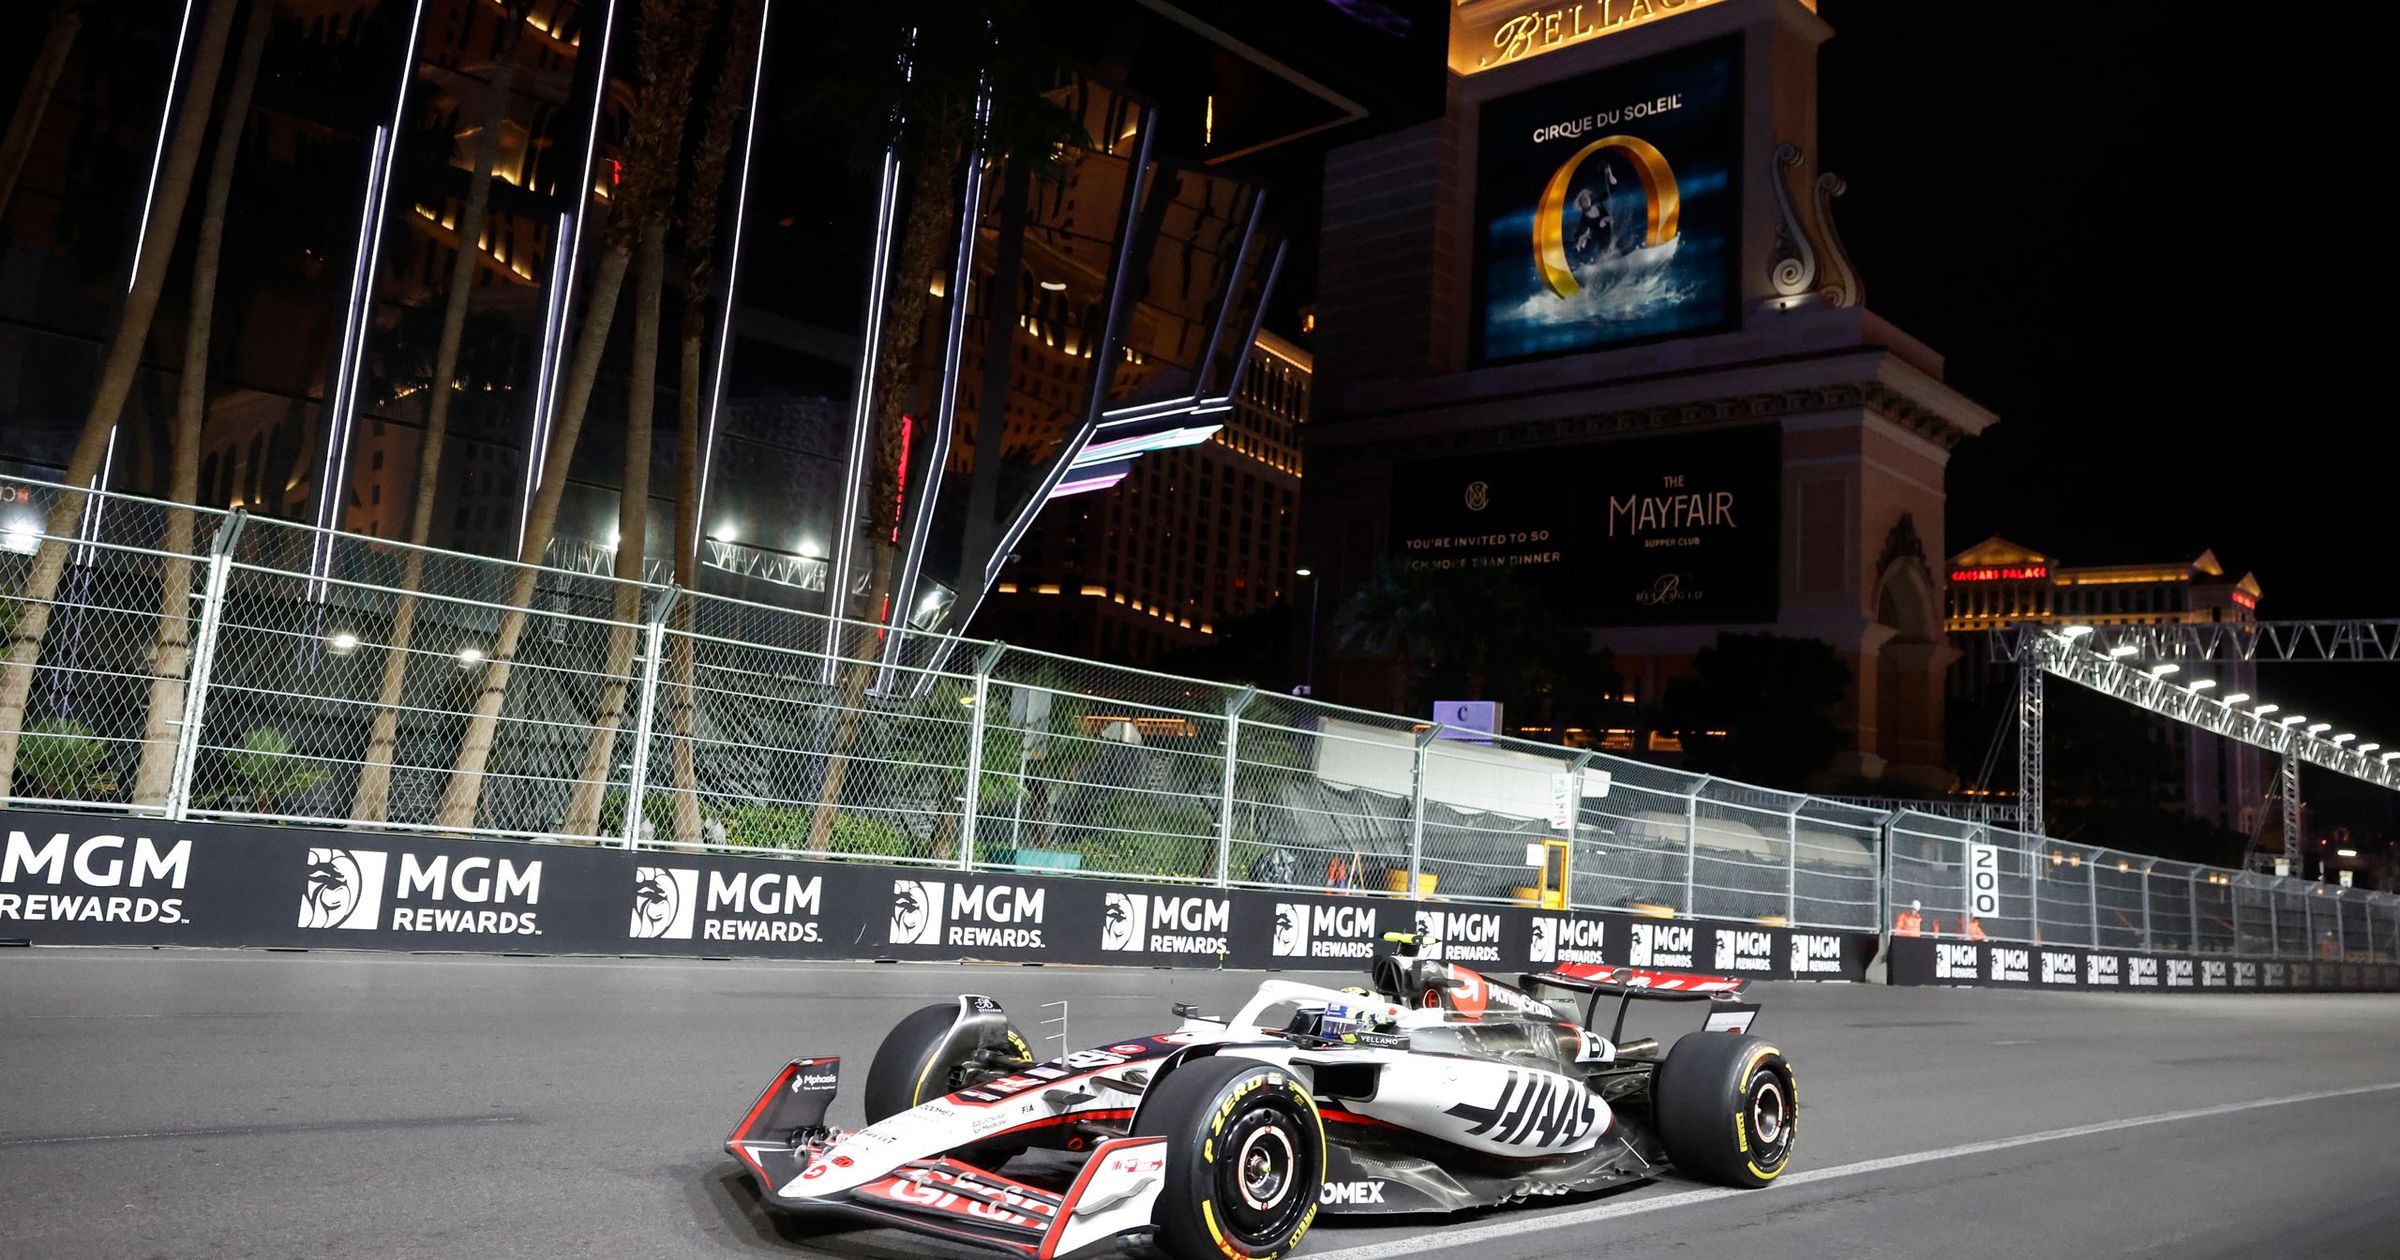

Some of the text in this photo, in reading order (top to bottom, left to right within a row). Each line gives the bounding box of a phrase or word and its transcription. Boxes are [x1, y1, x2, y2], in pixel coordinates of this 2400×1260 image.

[1480, 0, 1704, 66] BELLA
[1533, 117, 1593, 143] CIRQUE
[1597, 110, 1620, 128] DU
[1662, 474, 1685, 489] THE
[1608, 491, 1738, 538] MAYFAIR
[1406, 529, 1550, 551] YOU'RE INVITED TO SO
[1644, 535, 1701, 549] SUPPER CLUB
[1509, 551, 1561, 566] DINNER
[2002, 567, 2047, 579] PALACE
[1, 831, 192, 888] MGM
[397, 853, 542, 904] MGM
[707, 871, 822, 915] MGM
[1976, 849, 1995, 913] 200
[951, 884, 1045, 923] MGM
[1152, 897, 1229, 932] MGM
[1313, 906, 1375, 938] MGM
[1446, 912, 1499, 942] MGM
[1559, 918, 1604, 947] MGM
[1654, 926, 1693, 951] MGM
[1736, 932, 1771, 956] MGM
[1808, 936, 1840, 958] MGM
[1951, 945, 1978, 966] MGM
[1360, 1034, 1398, 1046] VELLAMO
[803, 1073, 837, 1086] Mphasis
[1203, 1076, 1263, 1164] P ZERO
